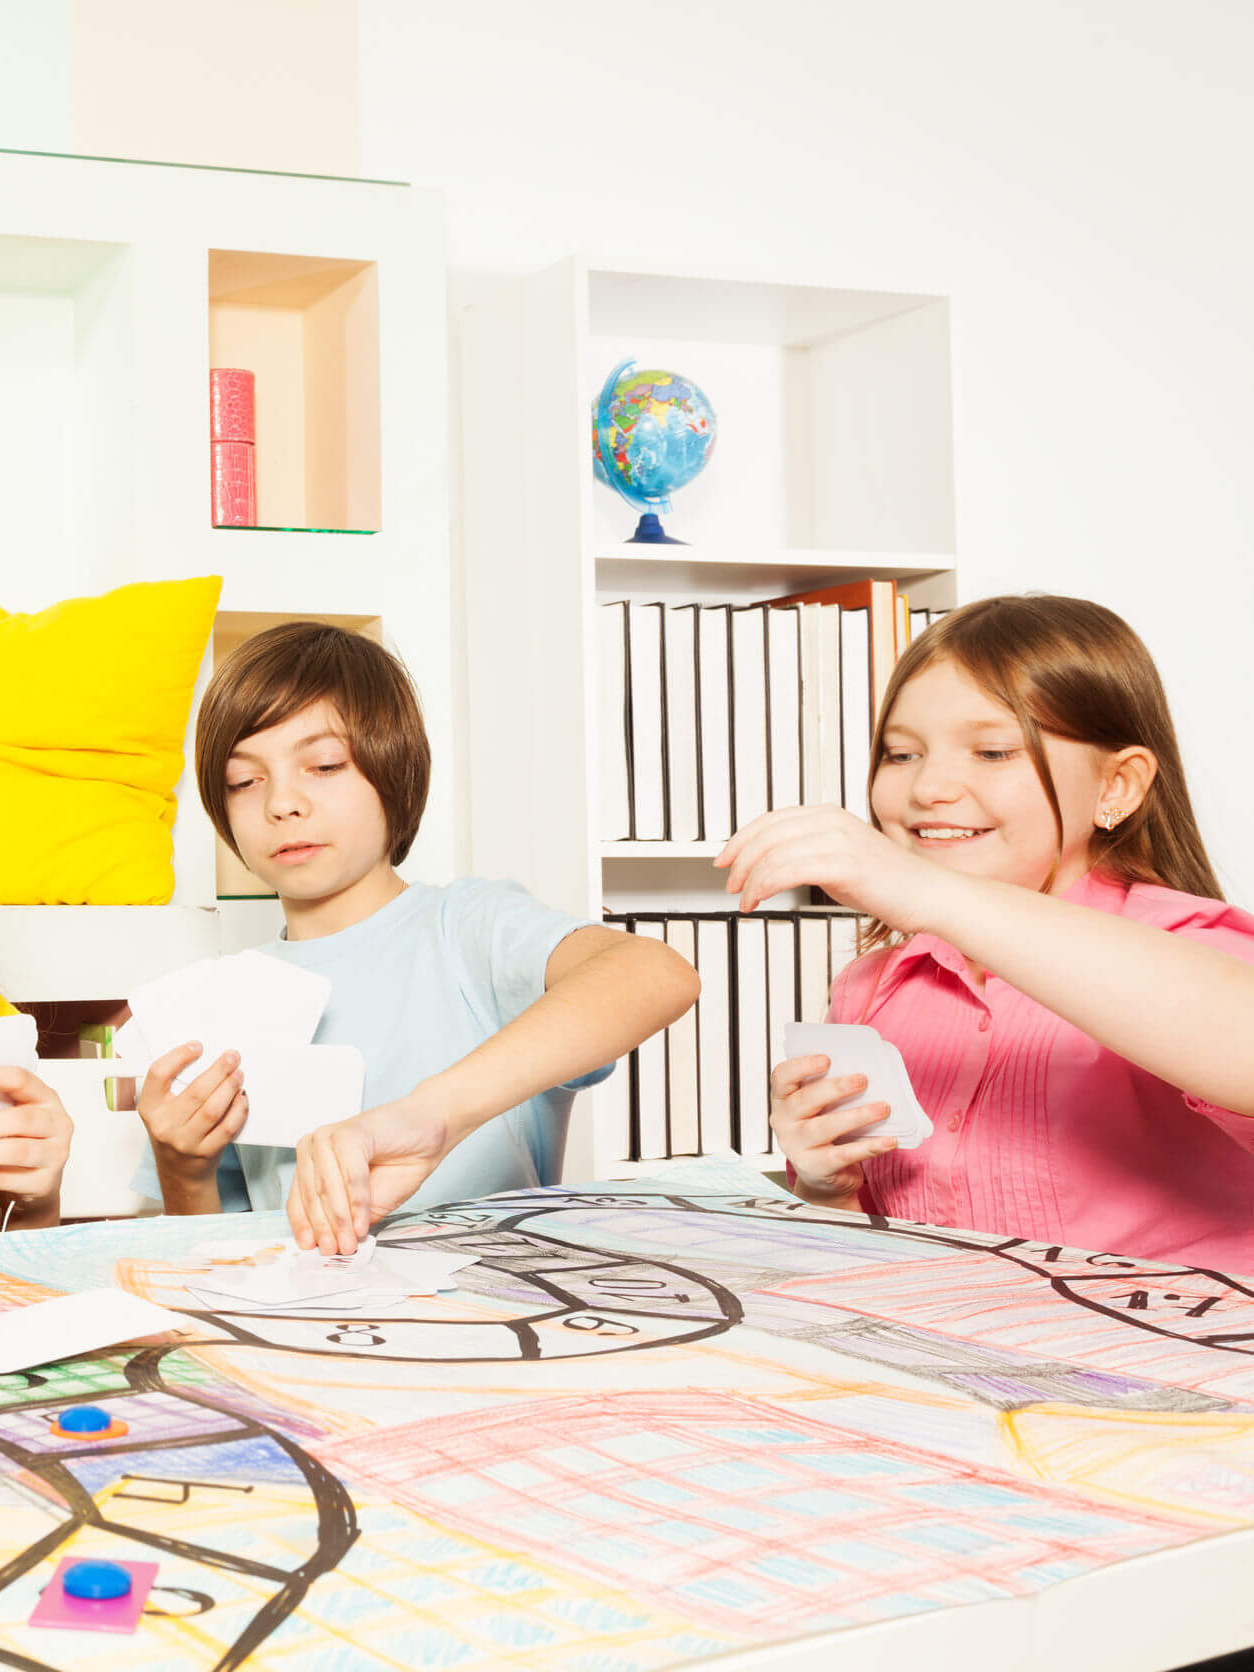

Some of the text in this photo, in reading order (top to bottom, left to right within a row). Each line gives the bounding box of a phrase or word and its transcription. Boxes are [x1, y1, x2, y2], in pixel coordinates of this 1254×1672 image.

[423, 1213, 493, 1229] 12
[588, 1278, 690, 1303] 10
[326, 1323, 387, 1346] 8
[562, 1315, 640, 1336] 9
[112, 1473, 254, 1505] 4
